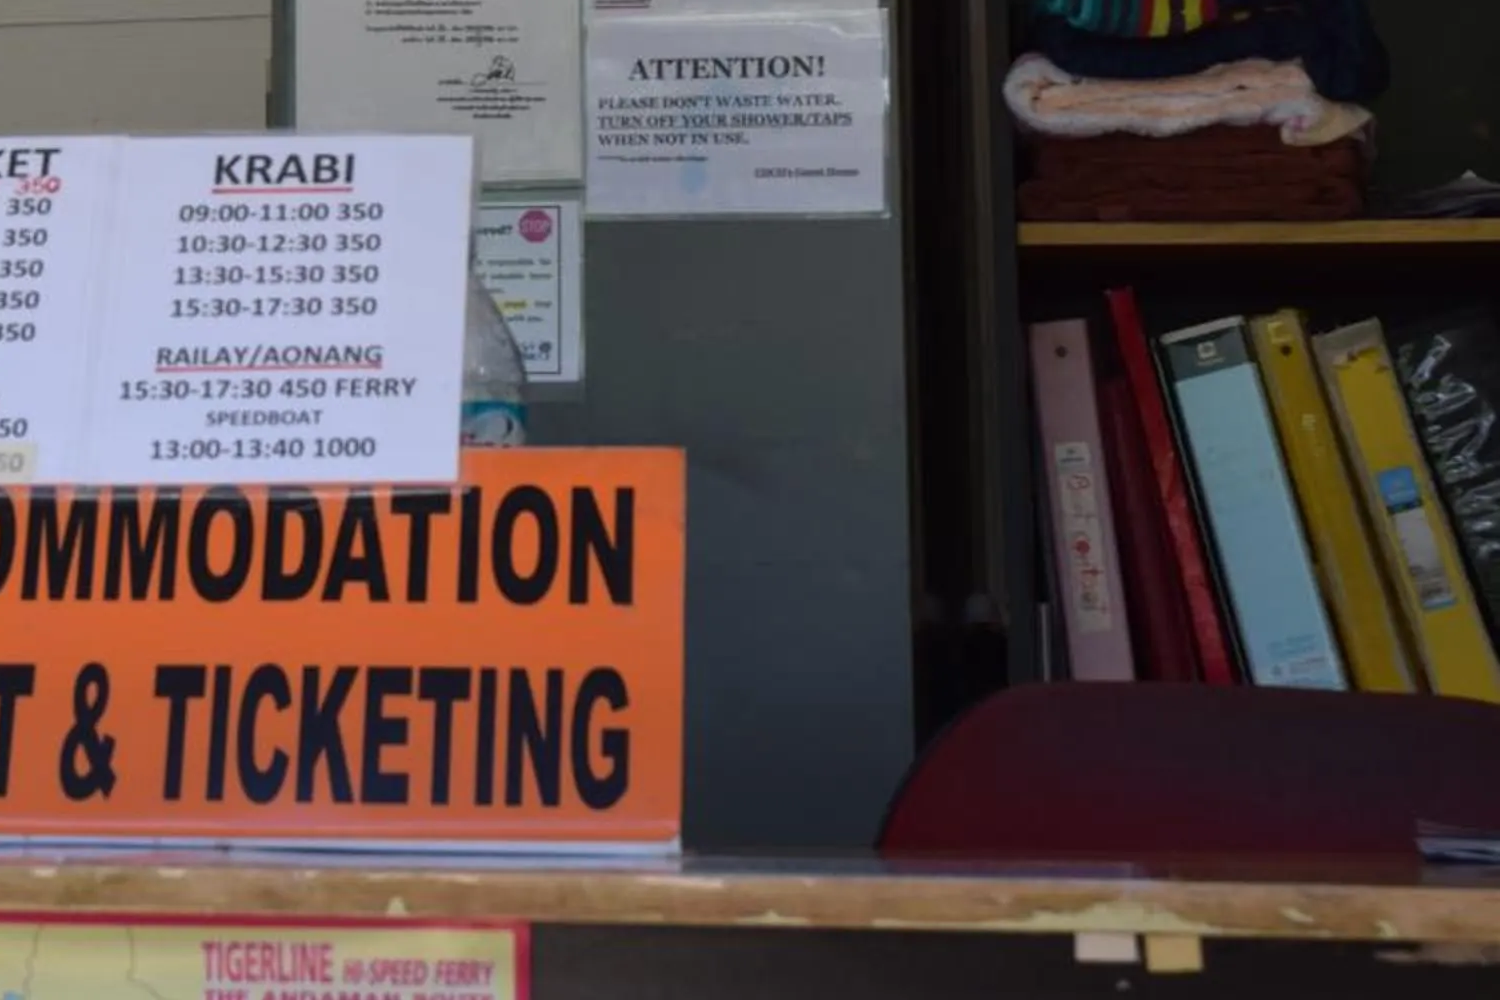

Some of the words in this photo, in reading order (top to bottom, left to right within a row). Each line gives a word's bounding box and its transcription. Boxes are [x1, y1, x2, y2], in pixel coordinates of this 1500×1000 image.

[628, 55, 826, 81] ATTENTION!
[599, 96, 660, 110] PLEASE
[663, 95, 710, 109] DON'T
[714, 94, 776, 108] WASTE
[598, 115, 642, 130] TURN
[646, 114, 677, 128] OFF
[680, 113, 727, 128] YOUR
[730, 112, 853, 127] SHOWER/TAPS
[598, 133, 650, 147] WHEN
[653, 132, 687, 146] NOT
[691, 132, 709, 145] IN
[213, 153, 356, 186] KRABI
[5, 197, 53, 216] 350
[178, 203, 330, 223] 09:00-11:00
[336, 202, 384, 221] 350
[1, 228, 49, 247] 350
[177, 234, 328, 254] 10:30-12:30
[334, 233, 382, 253] 350
[174, 265, 325, 286] 13:30-15:30
[330, 264, 380, 284] 350
[170, 297, 323, 318] 15:30-17:30
[329, 296, 378, 317] 350
[155, 344, 383, 367] RAILAY/AONANG
[119, 379, 272, 400] 15:30-17:30
[277, 378, 328, 399] 450
[334, 376, 418, 398] FERRY
[204, 409, 323, 428] SPEEDBOAT
[150, 438, 305, 461] 13:00-13:40
[313, 437, 377, 458] 1000
[59, 661, 116, 800] &
[153, 663, 630, 810] TICKETING
[202, 941, 334, 984] TIGERLINE
[433, 959, 495, 987] FERRY
